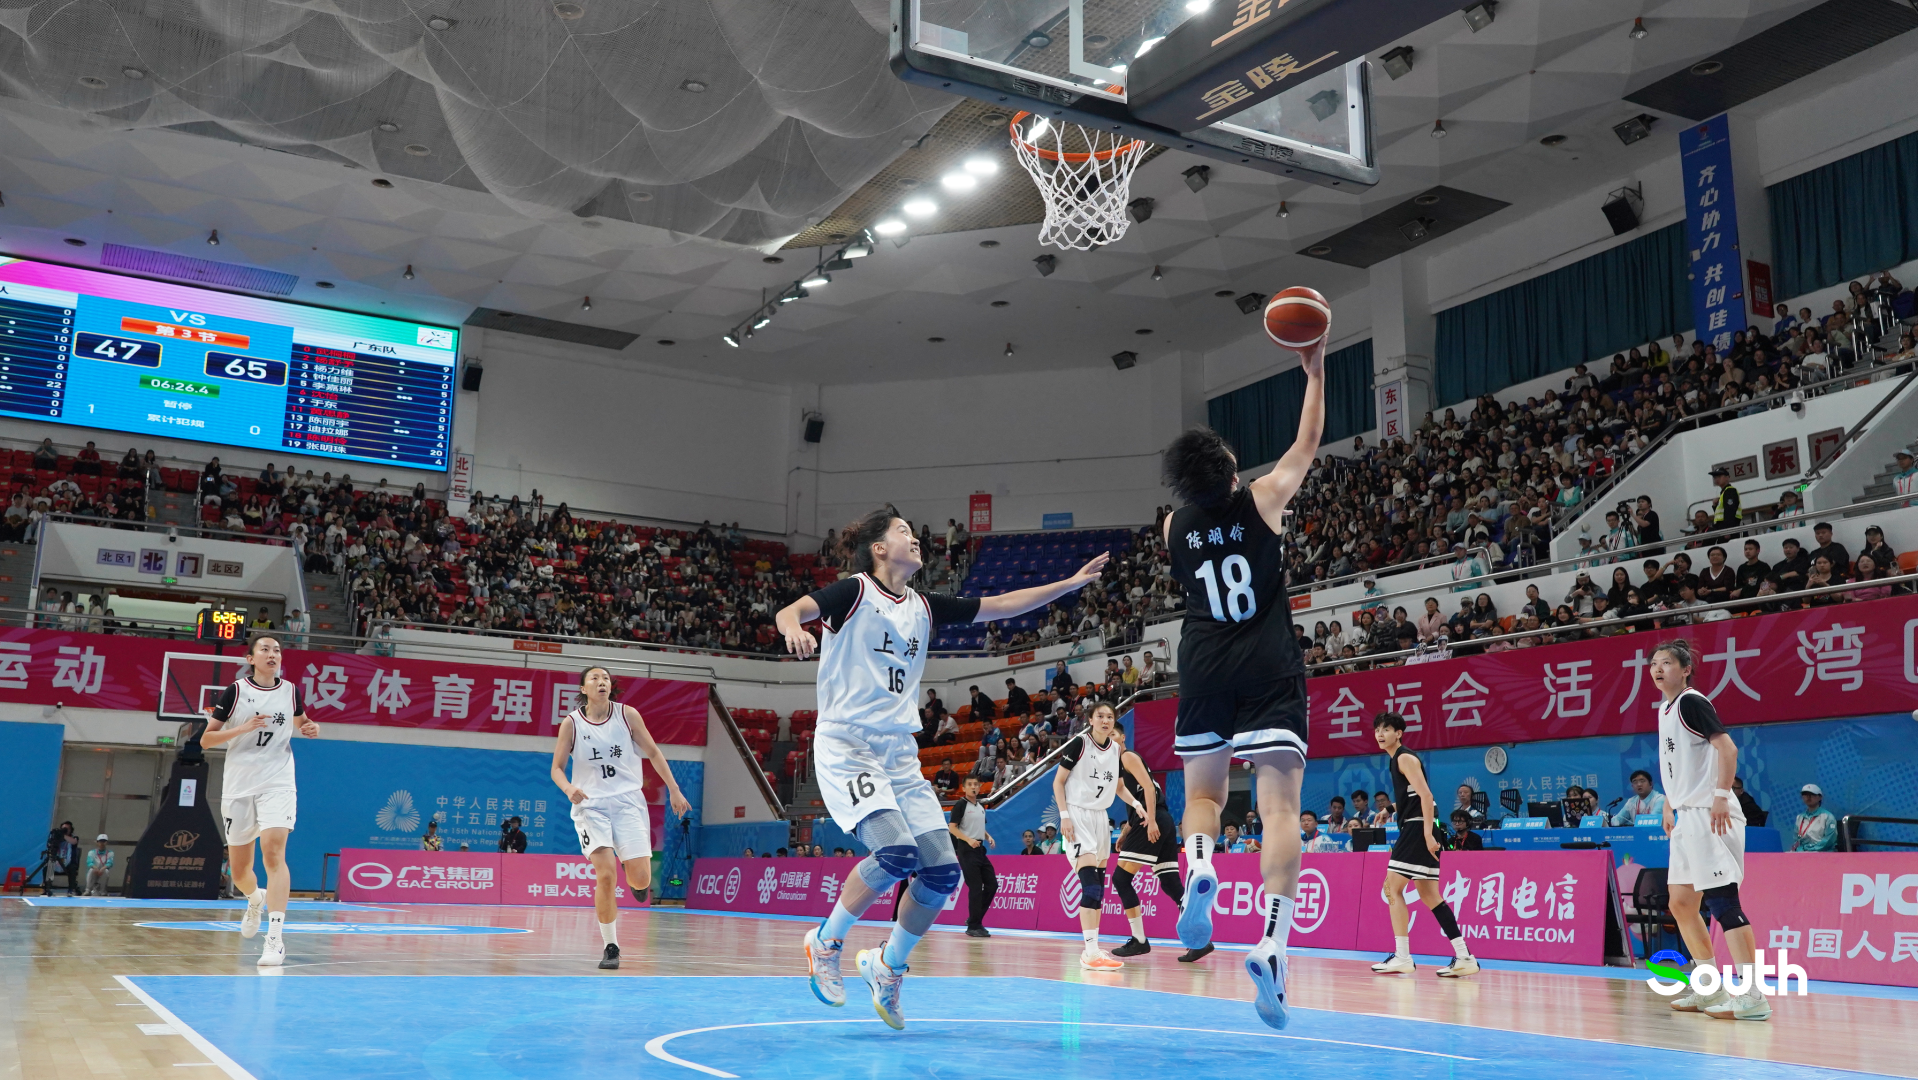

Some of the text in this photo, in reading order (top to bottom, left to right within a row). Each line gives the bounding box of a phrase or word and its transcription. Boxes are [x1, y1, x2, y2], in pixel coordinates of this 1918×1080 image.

[1697, 165, 1721, 253] 齐心协力
[1704, 263, 1731, 352] 共创佳绩
[169, 310, 207, 326] VS
[54, 335, 68, 343] 10
[93, 339, 142, 361] 47
[353, 341, 397, 355] 广东队
[224, 358, 267, 380] 65
[52, 390, 60, 398] 3
[150, 378, 209, 395] 06:26.4
[88, 404, 95, 414] 1
[163, 399, 193, 411] 暂停
[1385, 388, 1398, 437] 东一区
[147, 413, 205, 428] 累计犯规
[290, 422, 303, 430] 17
[291, 414, 303, 422] 13
[249, 425, 261, 436] 0
[289, 431, 302, 439] 18
[429, 449, 443, 457] 20
[435, 458, 442, 466] 4
[1185, 522, 1245, 550] 陈明伶
[101, 551, 131, 564] 北区1
[211, 562, 240, 574] 北区2
[1194, 554, 1257, 623] 18
[218, 623, 235, 639] 18
[873, 631, 919, 660] 上海
[1541, 618, 1918, 721] 活力大湾
[887, 666, 906, 694] 16
[255, 711, 286, 727] 海
[256, 730, 274, 747] 17
[588, 744, 623, 760] 上海
[600, 764, 616, 779] 18
[1089, 767, 1114, 783] 上海
[846, 771, 876, 807] 16
[1498, 773, 1598, 791] 中华人民共和国
[1095, 785, 1104, 799] 7
[436, 795, 547, 813] 中华人民共和国
[1073, 843, 1082, 858] 7
[396, 865, 494, 881] 广汽集团
[779, 871, 812, 889] 中国联通
[396, 879, 494, 890] GAC GROUP
[696, 874, 724, 895] ICBC
[1104, 870, 1160, 897] 移动
[1442, 869, 1579, 923] 中国电信
[1840, 873, 1918, 916] PIC
[993, 896, 1036, 911] SOUTHERN
[1101, 898, 1122, 915] hina
[1494, 925, 1575, 944] TELECOM
